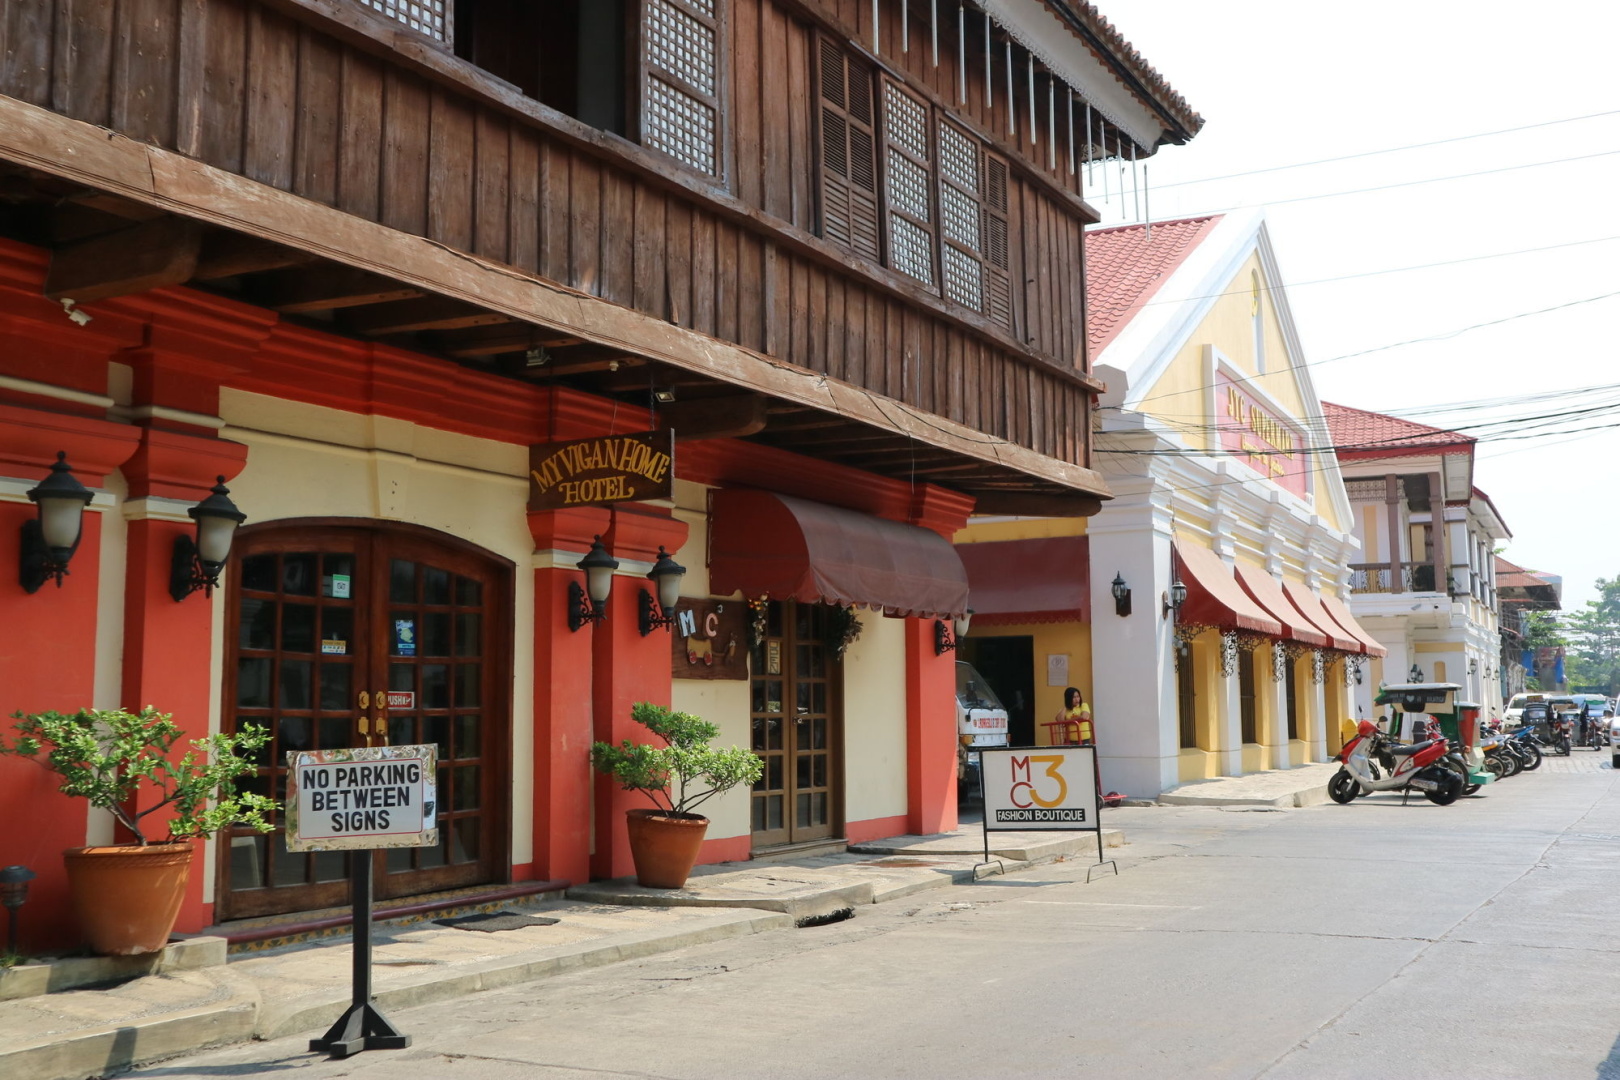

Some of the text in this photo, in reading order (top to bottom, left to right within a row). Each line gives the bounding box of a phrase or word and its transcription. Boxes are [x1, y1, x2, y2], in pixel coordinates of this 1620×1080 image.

[531, 438, 671, 494] MY VIGAN HOME
[558, 475, 634, 504] HOTEL
[303, 763, 420, 790] NO PARKING
[312, 786, 410, 811] BETWEEN
[331, 810, 390, 832] SIGNS
[997, 809, 1083, 821] FASHION BOUTIQUE
